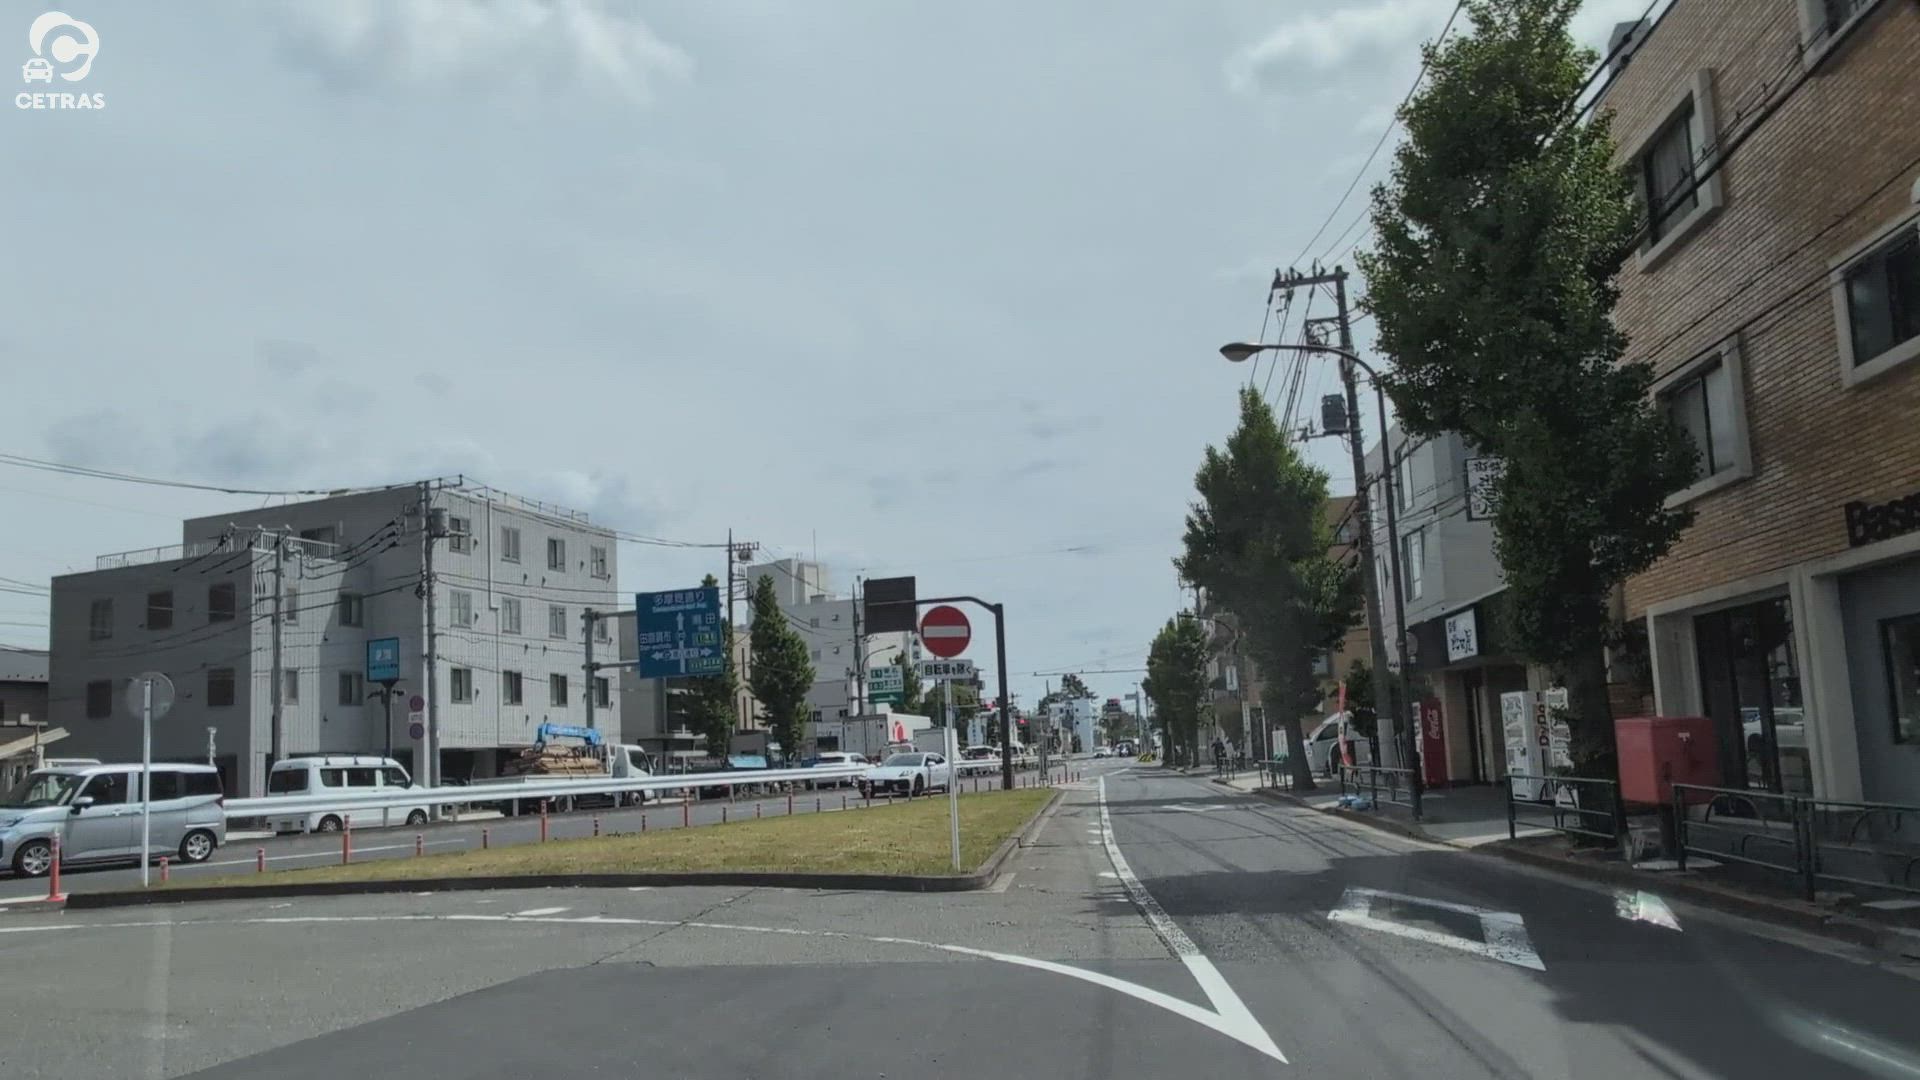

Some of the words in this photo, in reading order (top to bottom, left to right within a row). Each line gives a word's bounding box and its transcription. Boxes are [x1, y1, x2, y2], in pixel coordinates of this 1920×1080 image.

[924, 663, 972, 676] 自転車を除く
